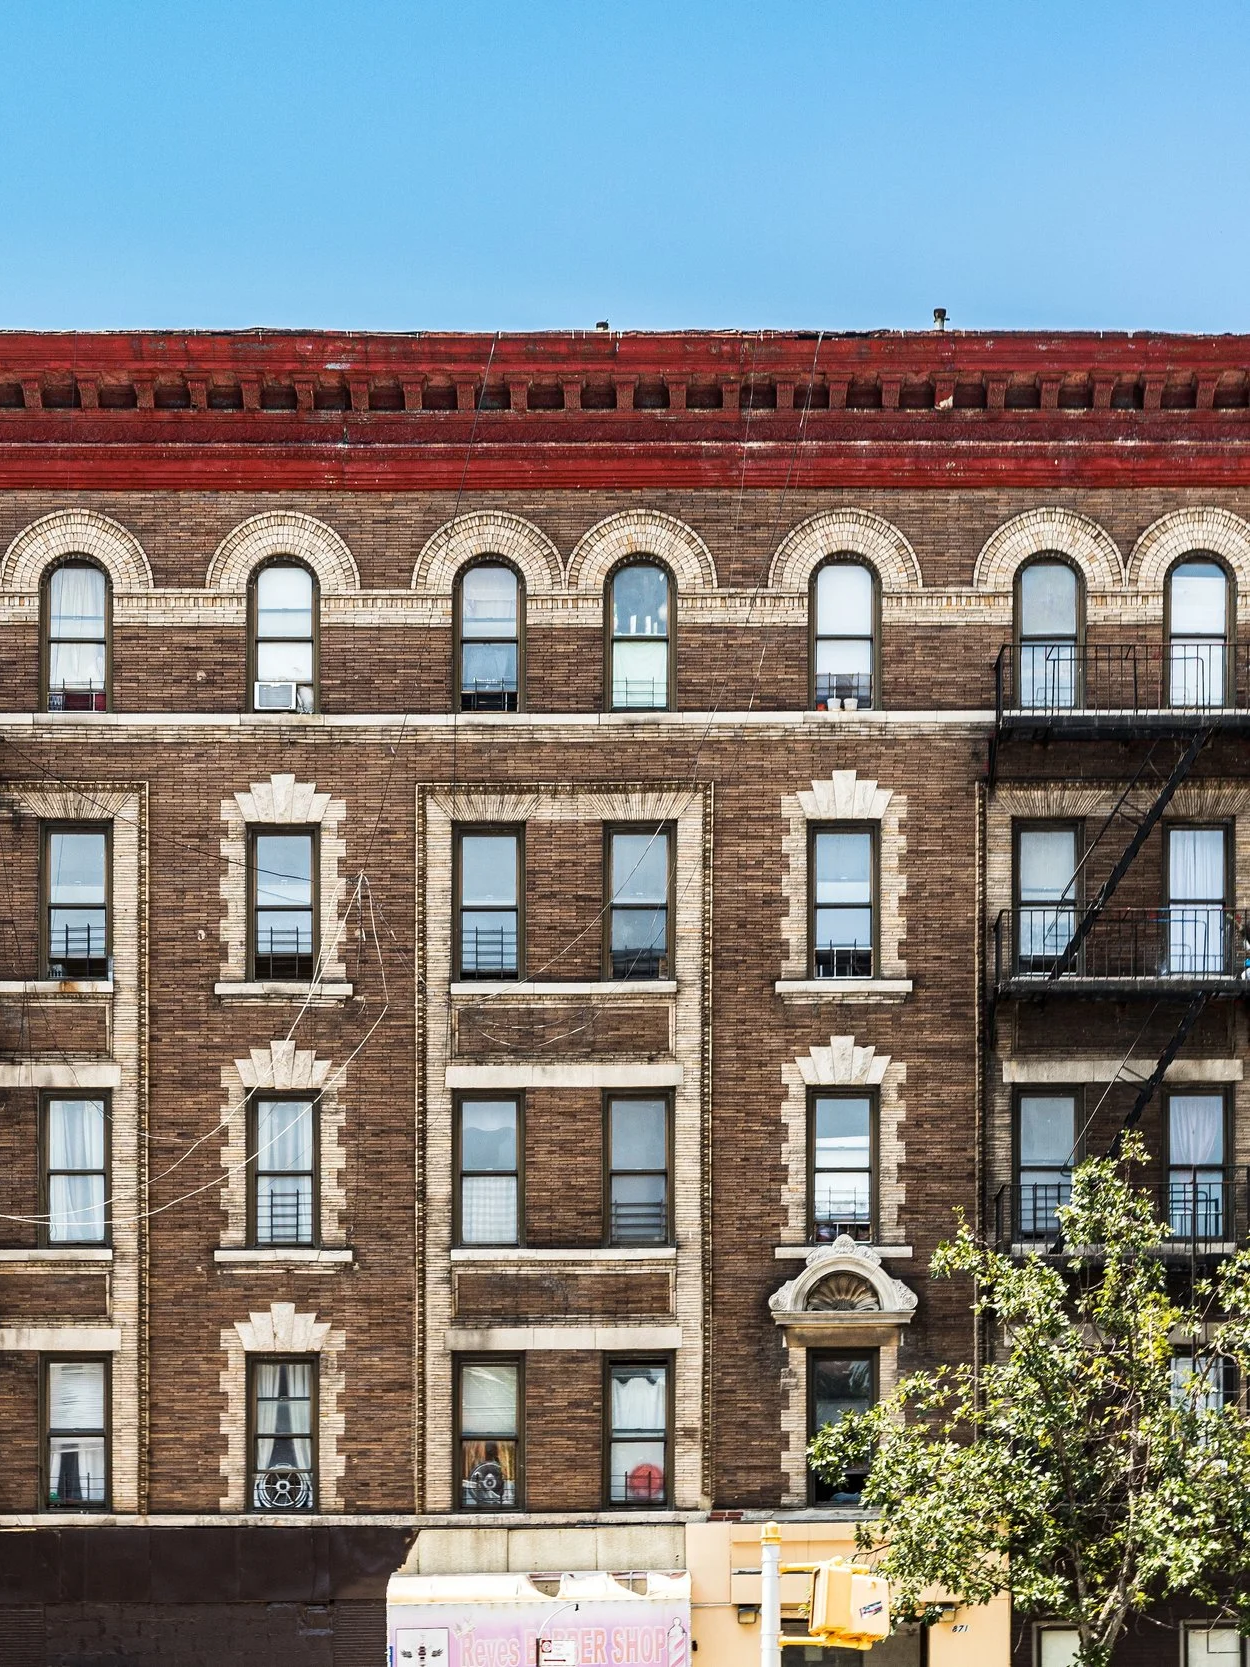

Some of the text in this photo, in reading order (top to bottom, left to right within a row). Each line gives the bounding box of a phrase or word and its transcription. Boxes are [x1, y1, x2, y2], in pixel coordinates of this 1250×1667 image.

[951, 1624, 969, 1633] 871
[460, 1632, 521, 1667] Reyes
[610, 1626, 668, 1664] SHOP
